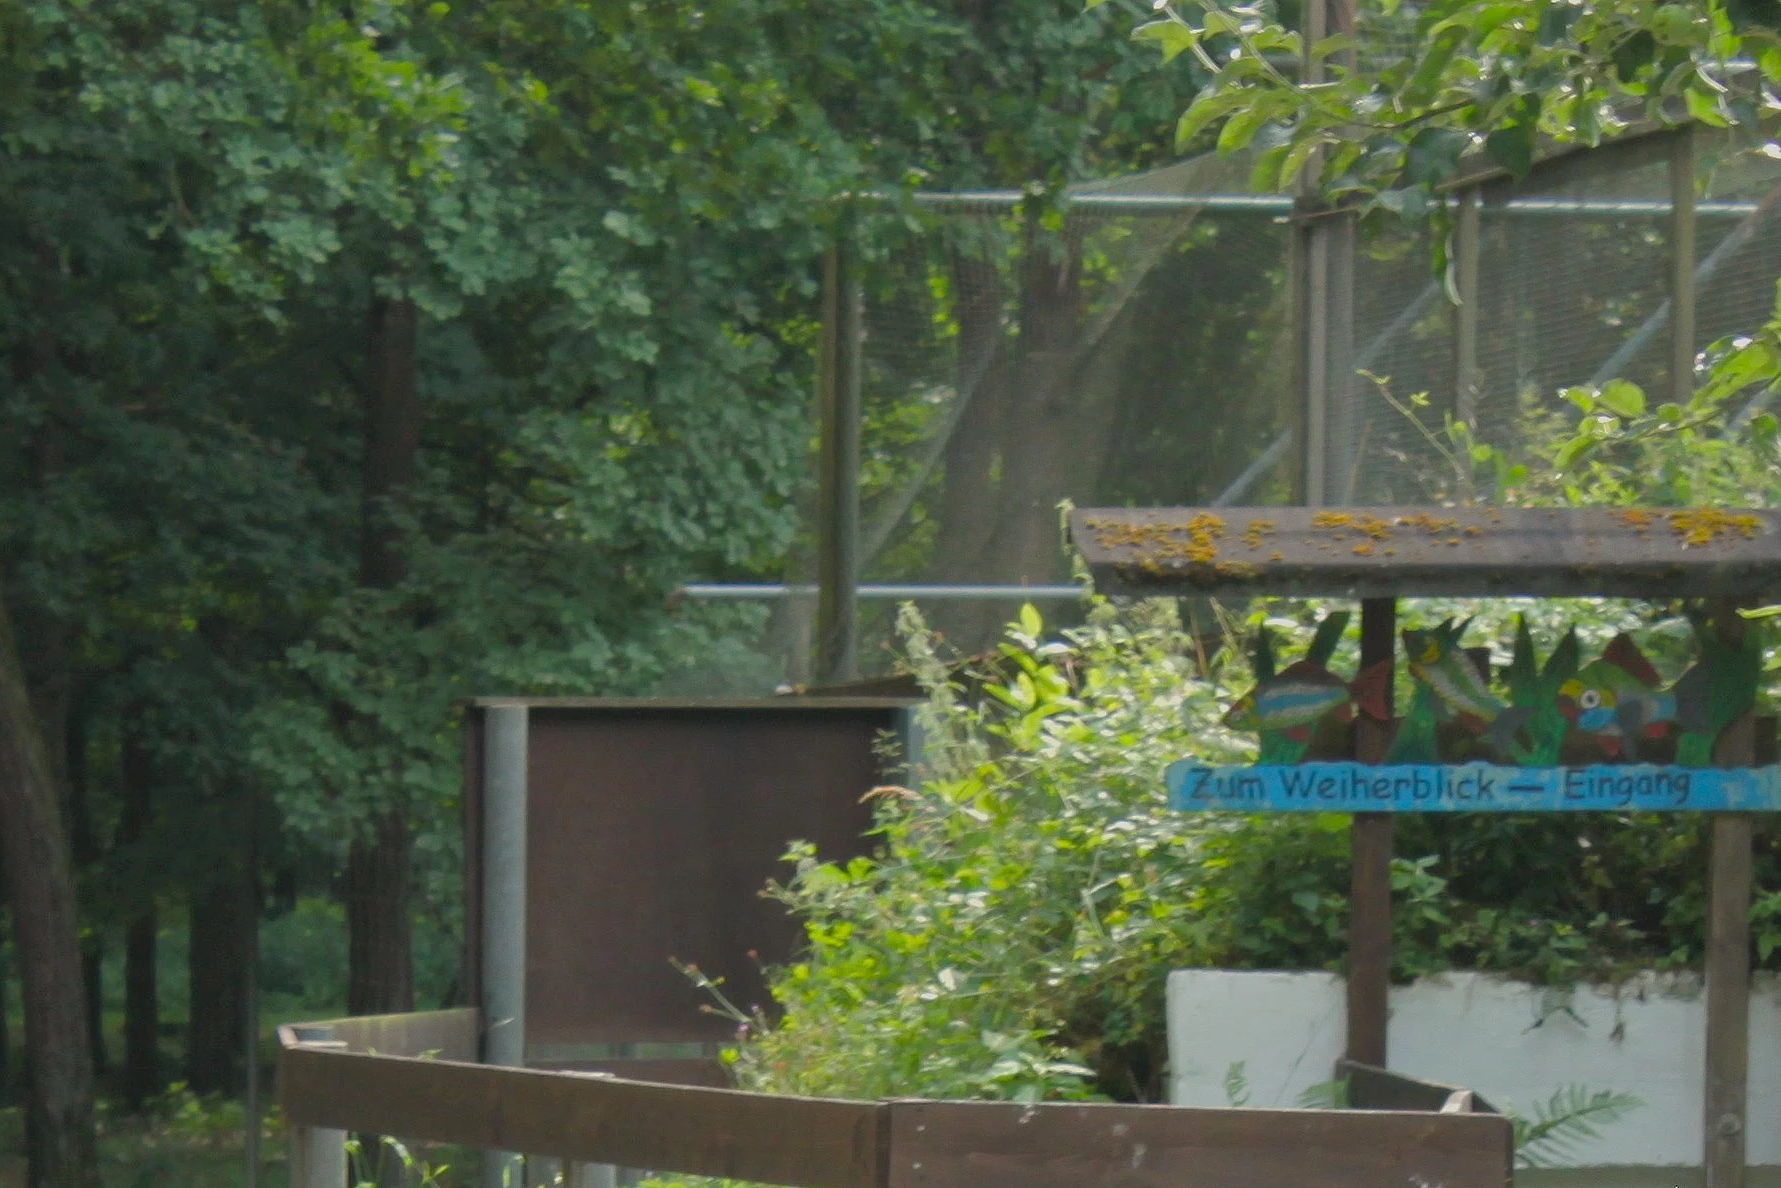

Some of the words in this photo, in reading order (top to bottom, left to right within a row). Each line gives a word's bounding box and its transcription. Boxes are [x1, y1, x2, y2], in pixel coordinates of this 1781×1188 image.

[1187, 767, 1266, 800] Zum
[1279, 767, 1495, 801] Weiherblick
[1563, 769, 1691, 805] Eingang
